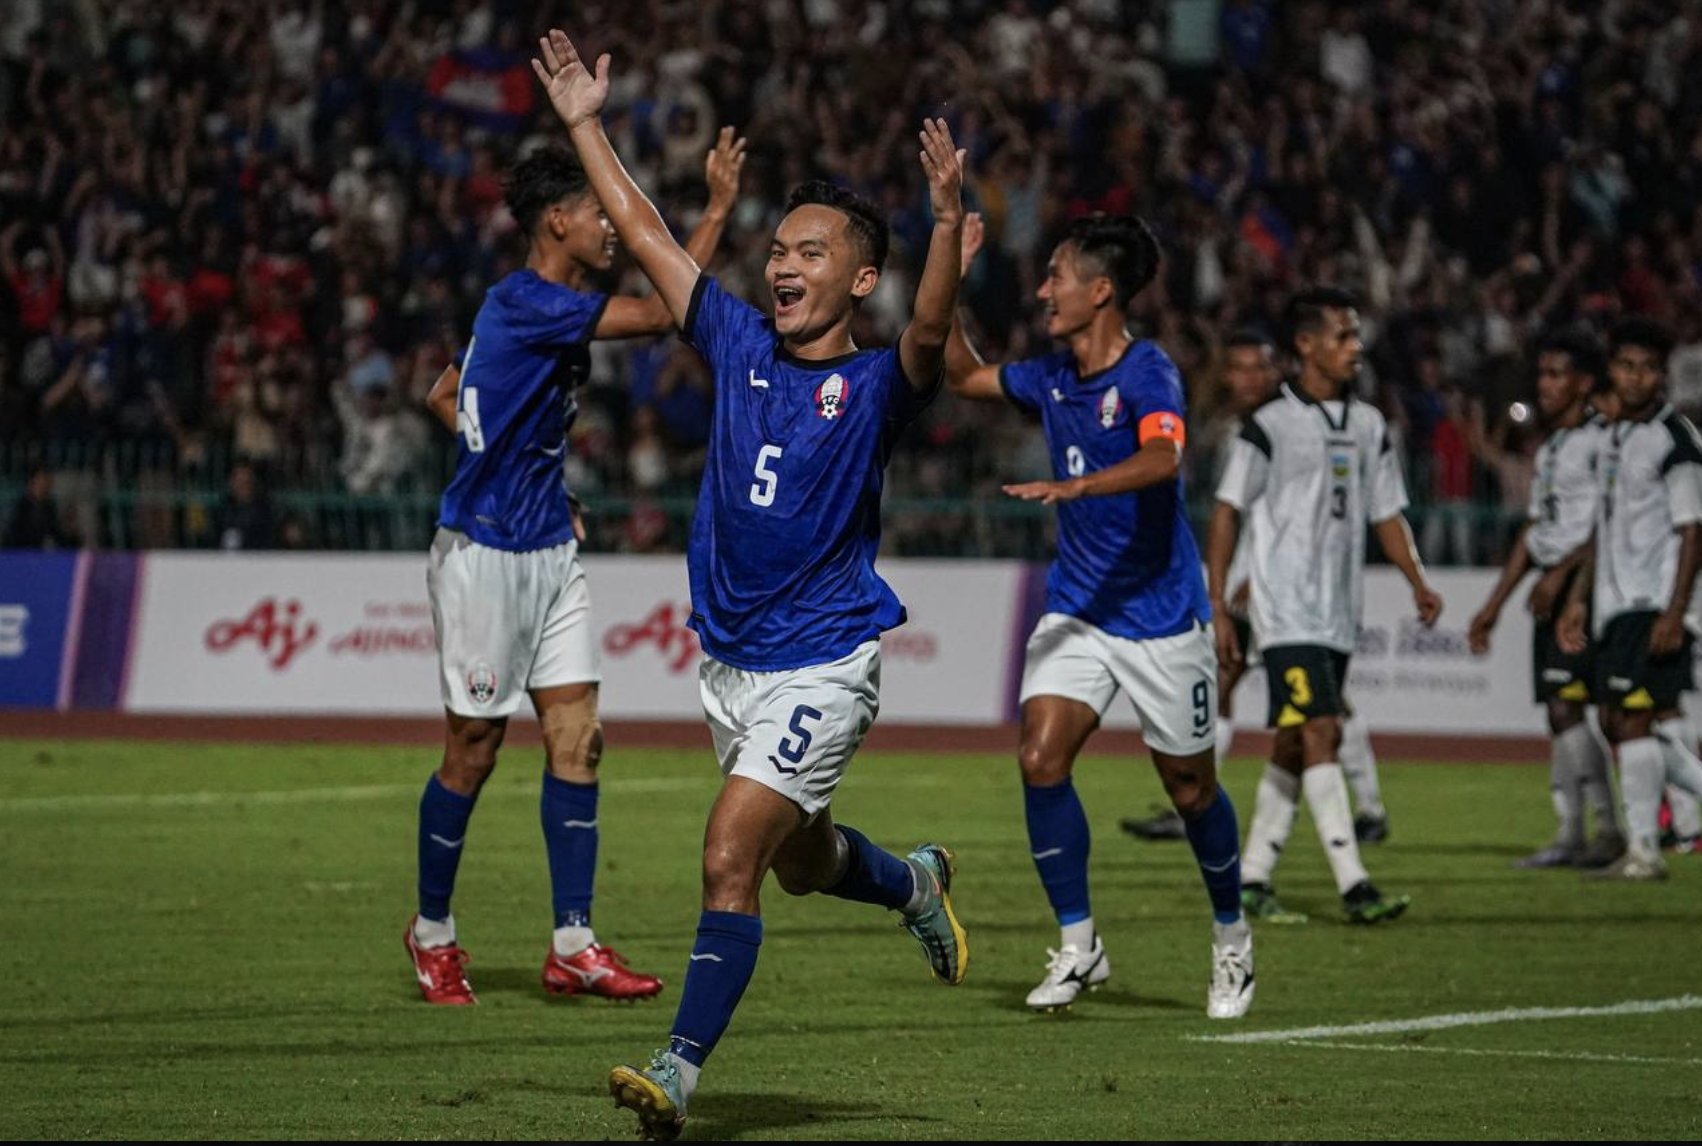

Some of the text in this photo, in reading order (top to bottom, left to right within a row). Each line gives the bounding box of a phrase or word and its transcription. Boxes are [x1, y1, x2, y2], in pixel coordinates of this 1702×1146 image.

[750, 444, 783, 507] 5
[1331, 485, 1348, 520] 3
[1192, 679, 1209, 728] 9
[1284, 666, 1312, 706] 3
[778, 703, 823, 764] 5
